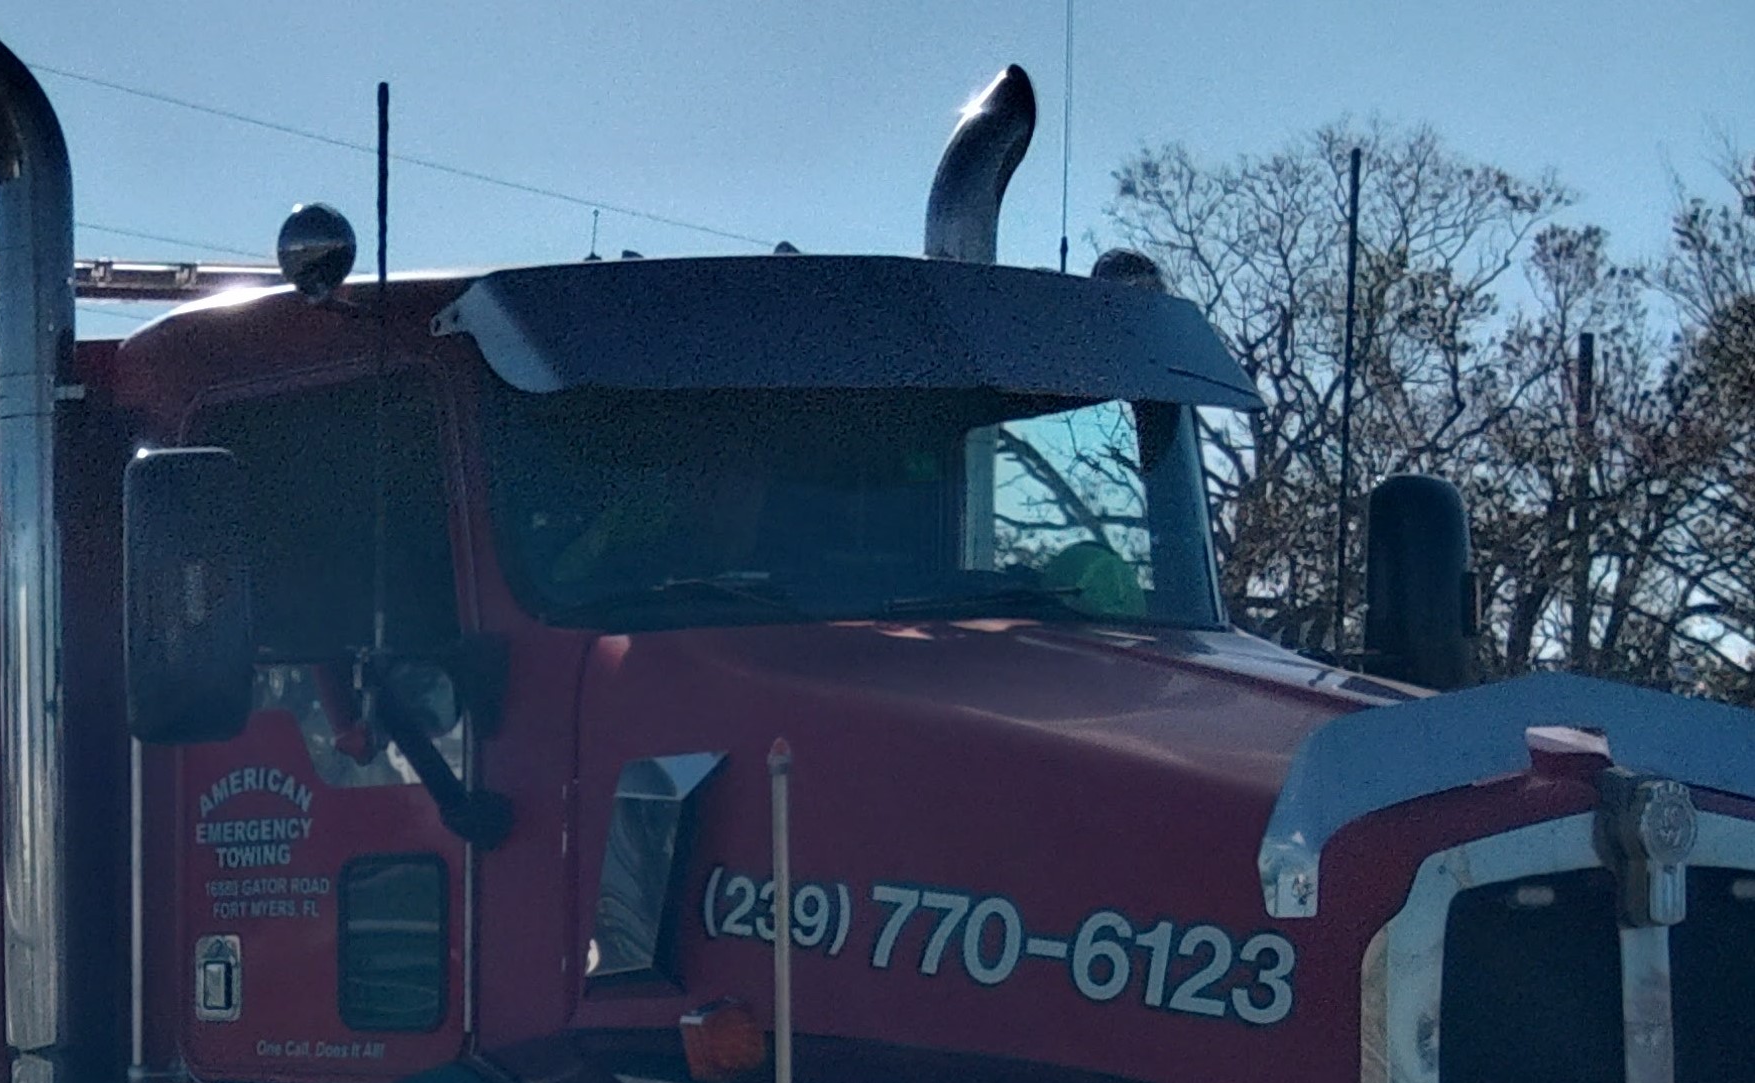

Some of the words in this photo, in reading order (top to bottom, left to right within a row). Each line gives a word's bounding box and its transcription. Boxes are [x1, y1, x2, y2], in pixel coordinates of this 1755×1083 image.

[199, 766, 314, 820] AMERICAN
[195, 817, 314, 844] EMERGENCY
[215, 843, 292, 868] TOWING
[242, 878, 287, 896] GATOR
[290, 877, 331, 895] ROAD
[212, 901, 246, 919] FORT
[703, 866, 851, 955] (239)
[870, 885, 1297, 1025] 770-6123
